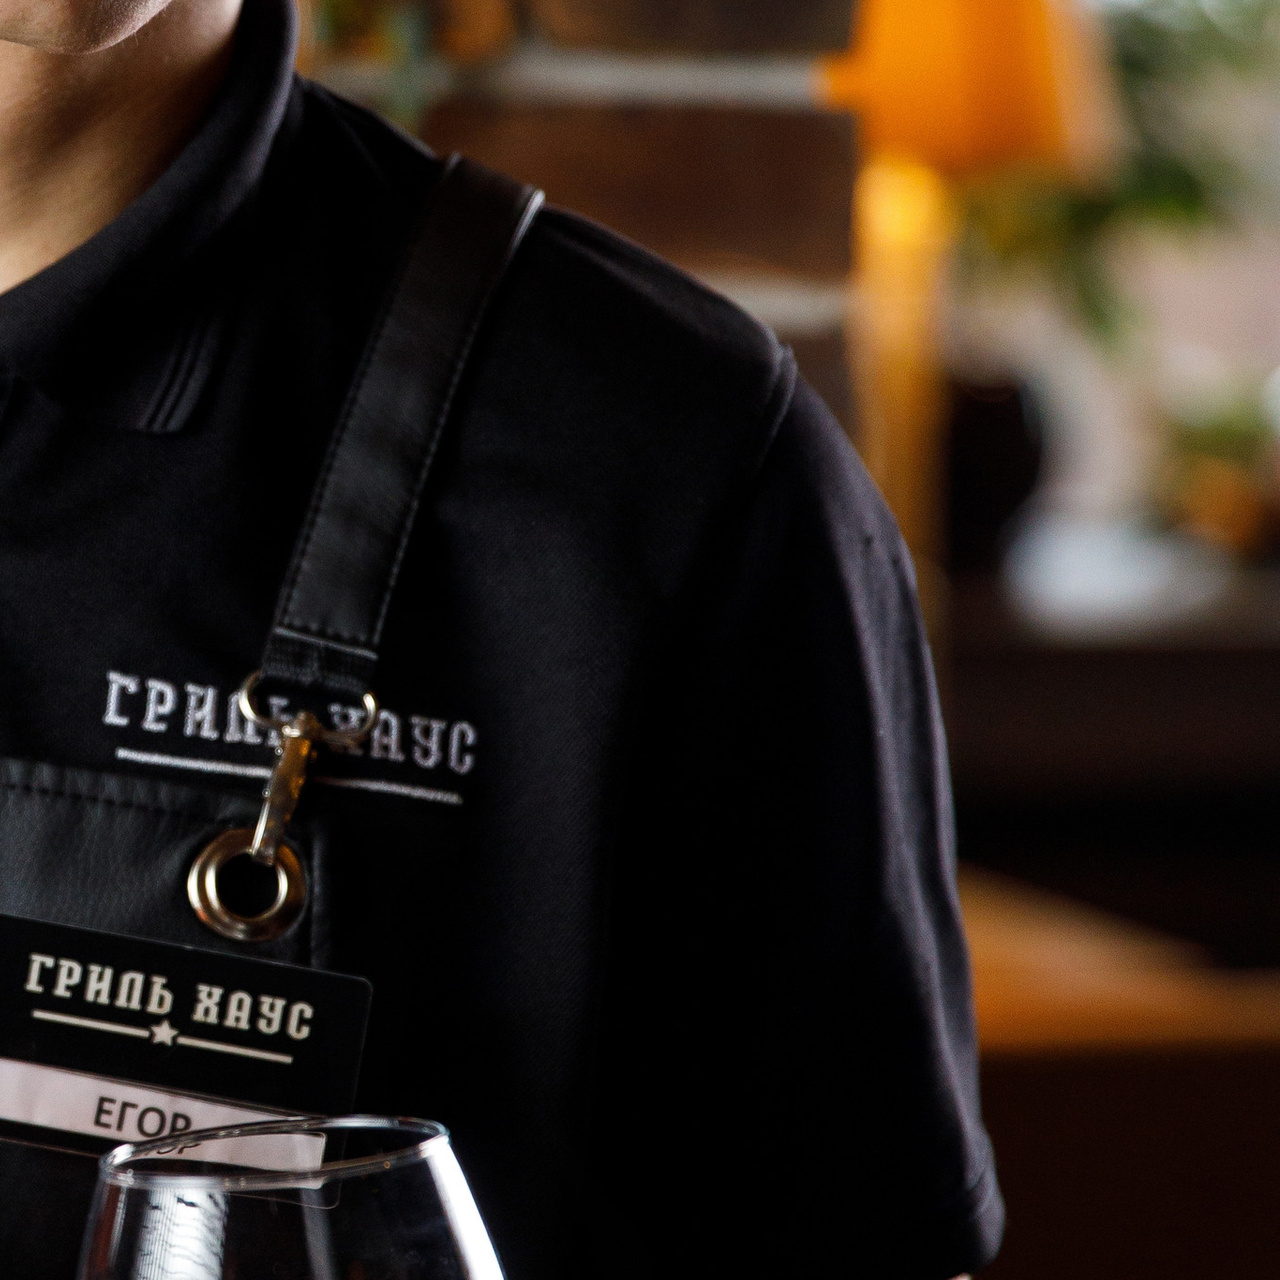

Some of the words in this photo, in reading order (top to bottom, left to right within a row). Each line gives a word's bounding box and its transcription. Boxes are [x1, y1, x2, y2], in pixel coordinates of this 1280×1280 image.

[24, 952, 174, 1016] ГРИЛЬ
[192, 982, 314, 1040] ХАУС
[93, 1095, 192, 1138] ЕГОР
